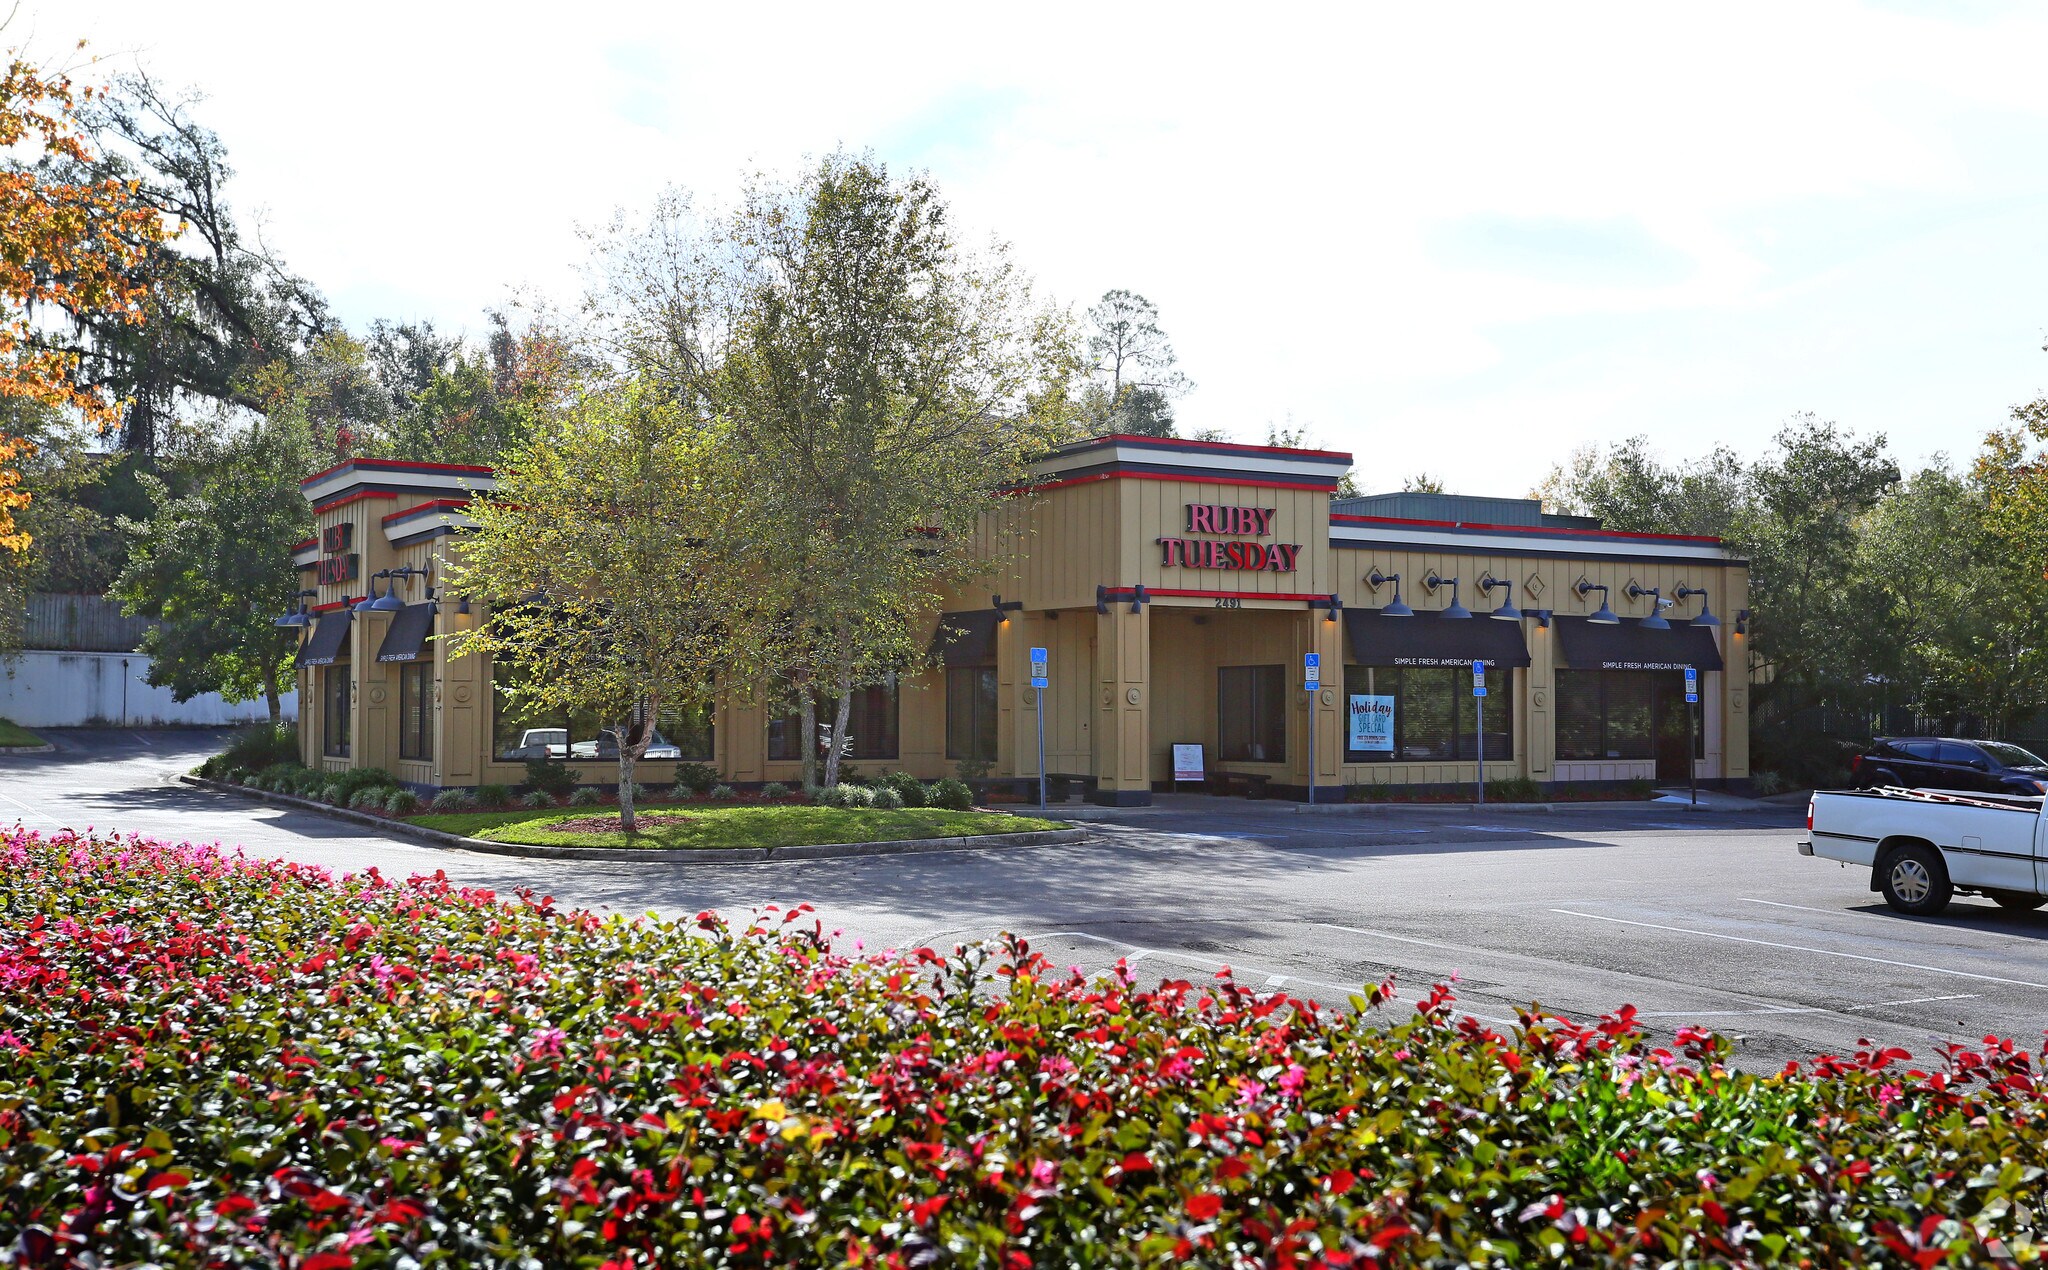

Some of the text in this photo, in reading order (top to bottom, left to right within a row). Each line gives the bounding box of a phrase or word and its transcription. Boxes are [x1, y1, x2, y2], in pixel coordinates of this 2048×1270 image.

[1185, 503, 1277, 536] RUBY
[1156, 537, 1303, 572] TUESDAY
[1215, 598, 1241, 608] 2491
[1394, 657, 1417, 665] SIMPLE
[1418, 658, 1439, 666] FRESH
[1440, 659, 1472, 667] AMERICAN
[1602, 661, 1622, 669] SIMPLE
[1623, 662, 1642, 670] FRESH
[1643, 662, 1672, 670] AMERICAN
[1351, 701, 1392, 717] Holiday
[1358, 714, 1386, 723] GIFT CARD
[1358, 722, 1385, 733] SPECIAL
